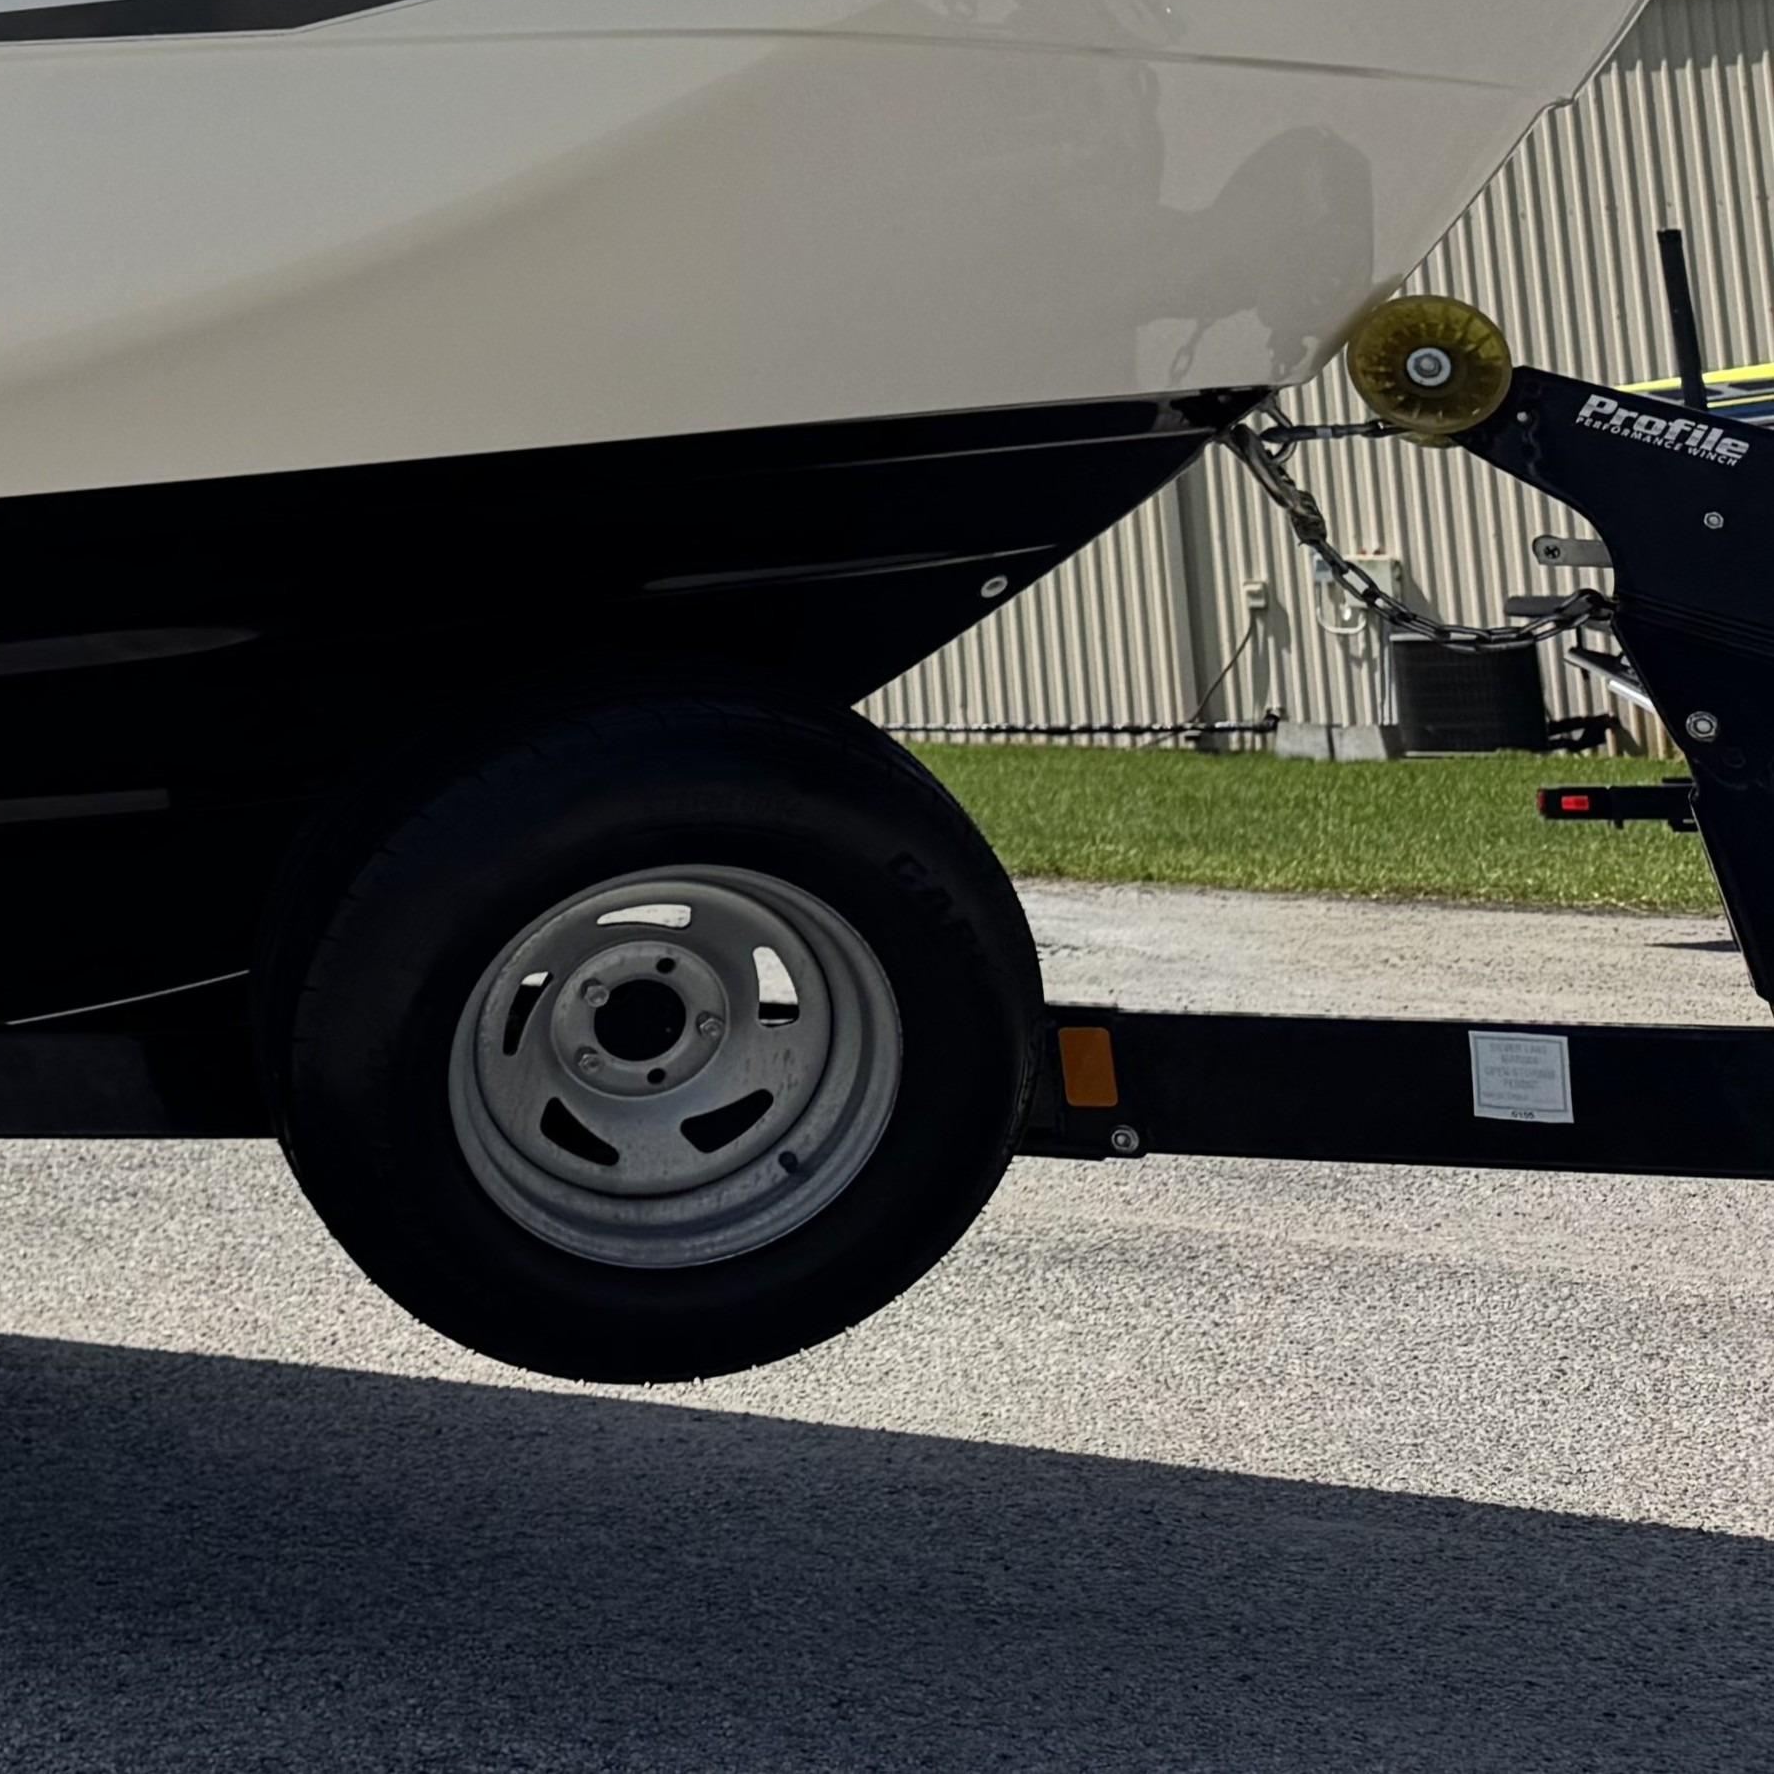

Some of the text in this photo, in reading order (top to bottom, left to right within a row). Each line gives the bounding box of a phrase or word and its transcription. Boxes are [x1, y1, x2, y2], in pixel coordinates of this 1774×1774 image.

[1576, 416, 1738, 467] PERFORMANCE WINCH
[1578, 394, 1750, 459] Profile
